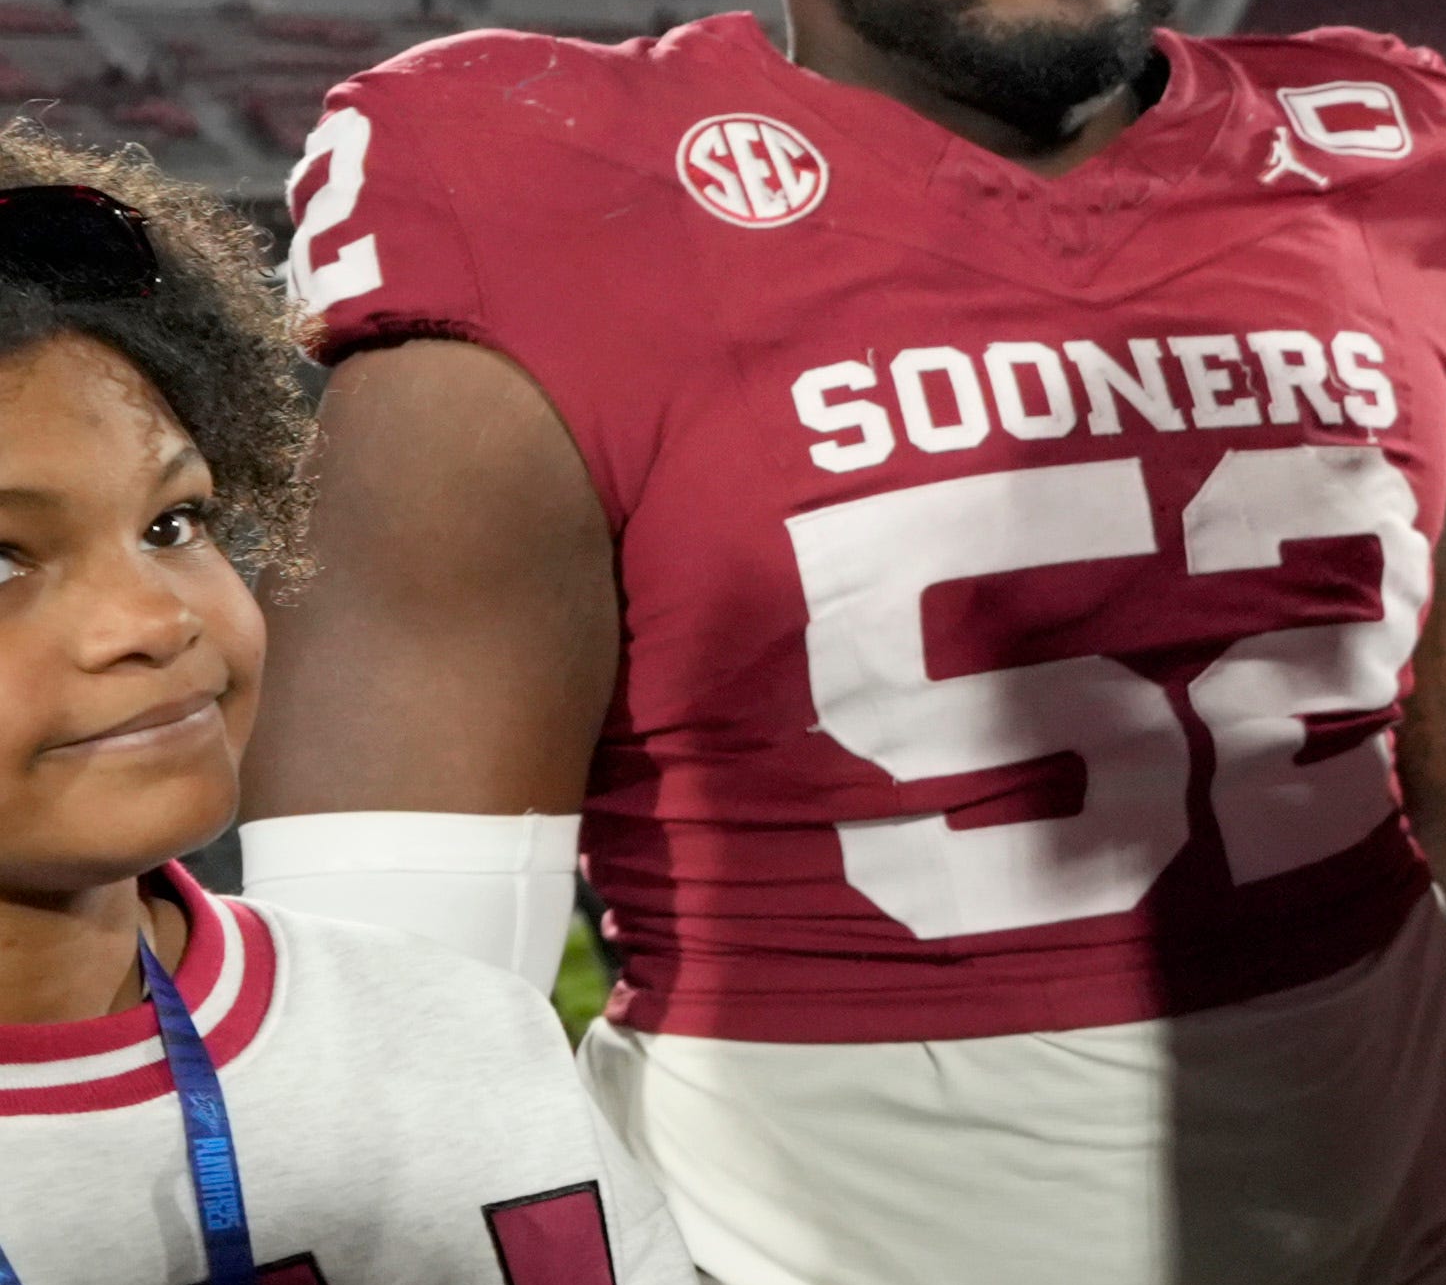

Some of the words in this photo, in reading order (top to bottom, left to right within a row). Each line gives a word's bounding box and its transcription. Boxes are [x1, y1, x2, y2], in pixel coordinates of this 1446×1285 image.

[688, 123, 817, 221] SEC
[791, 328, 1399, 473] SOONERS
[784, 445, 1432, 940] 52
